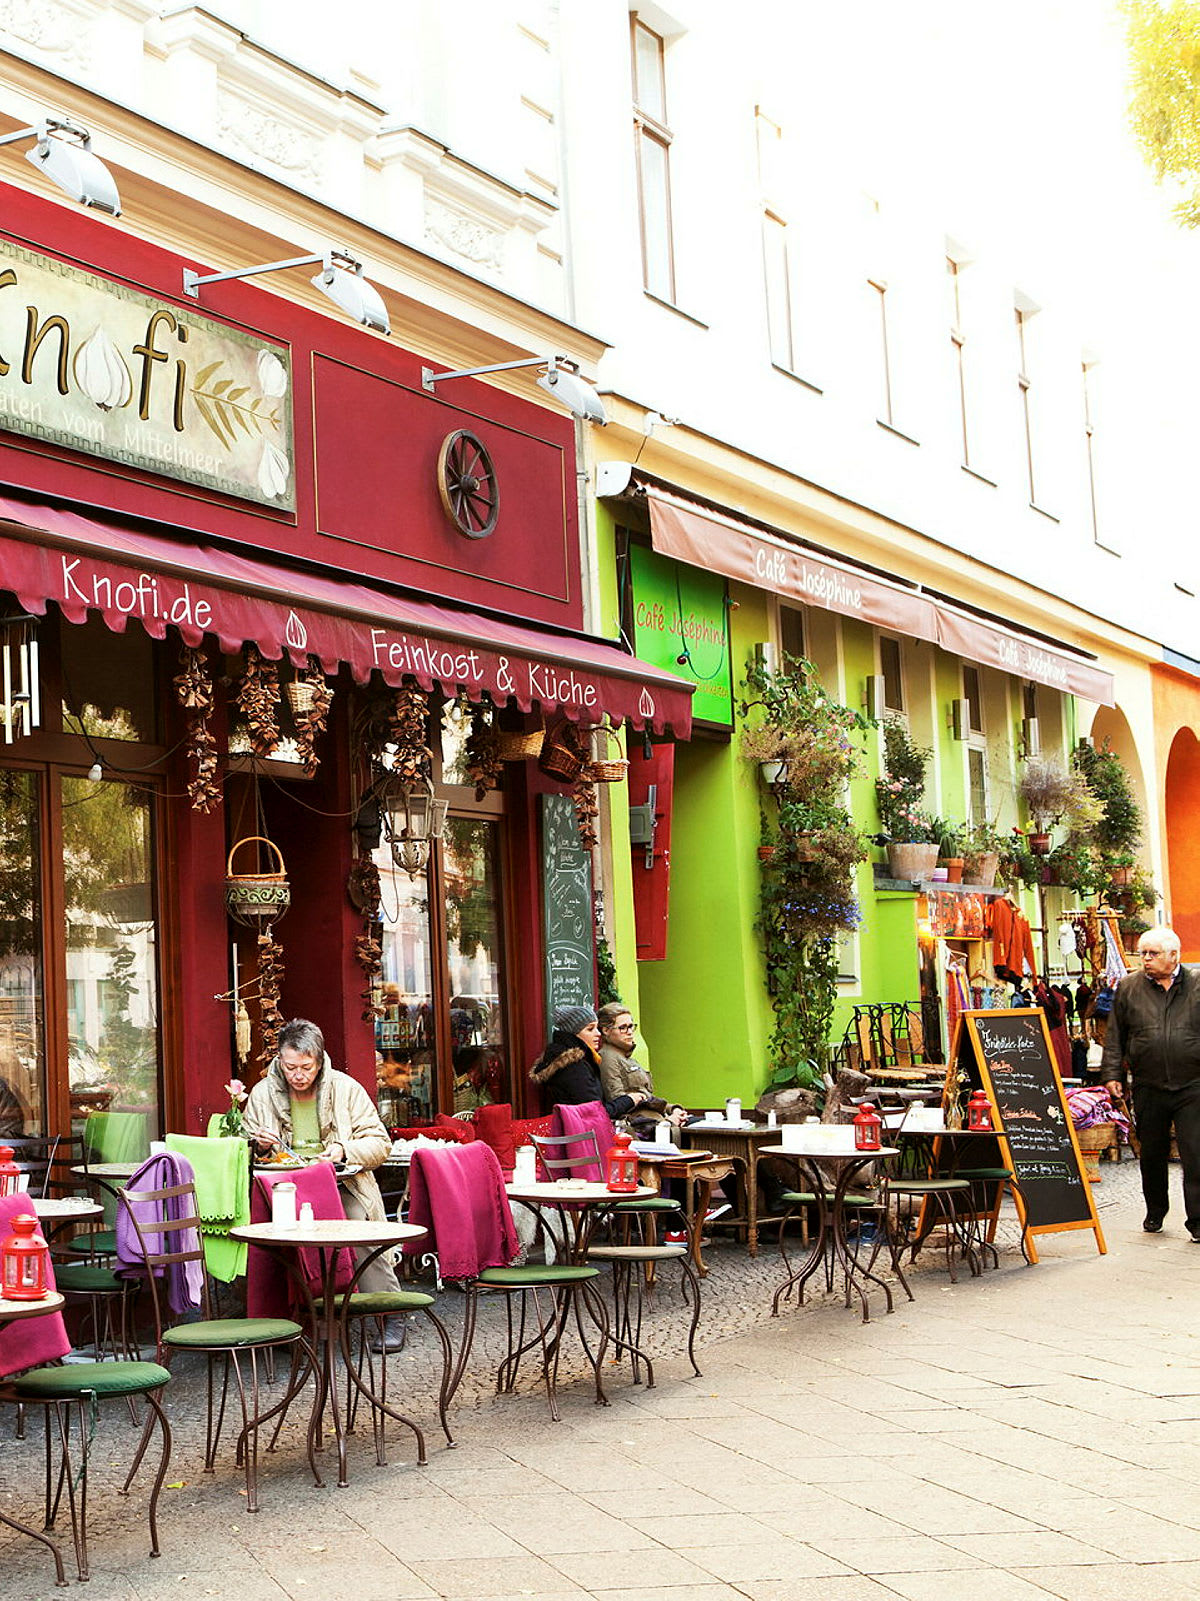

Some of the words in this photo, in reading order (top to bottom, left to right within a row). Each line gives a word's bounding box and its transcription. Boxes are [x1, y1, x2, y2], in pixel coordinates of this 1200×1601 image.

[62, 411, 106, 443] vom
[124, 424, 224, 476] Mittelmeer
[61, 555, 212, 628] Knofi.de
[756, 549, 787, 584] Café
[800, 565, 862, 610] Joséphine
[636, 602, 665, 632] Café
[370, 629, 484, 681] Feinkost
[497, 657, 515, 693] &
[527, 661, 597, 706] Küche
